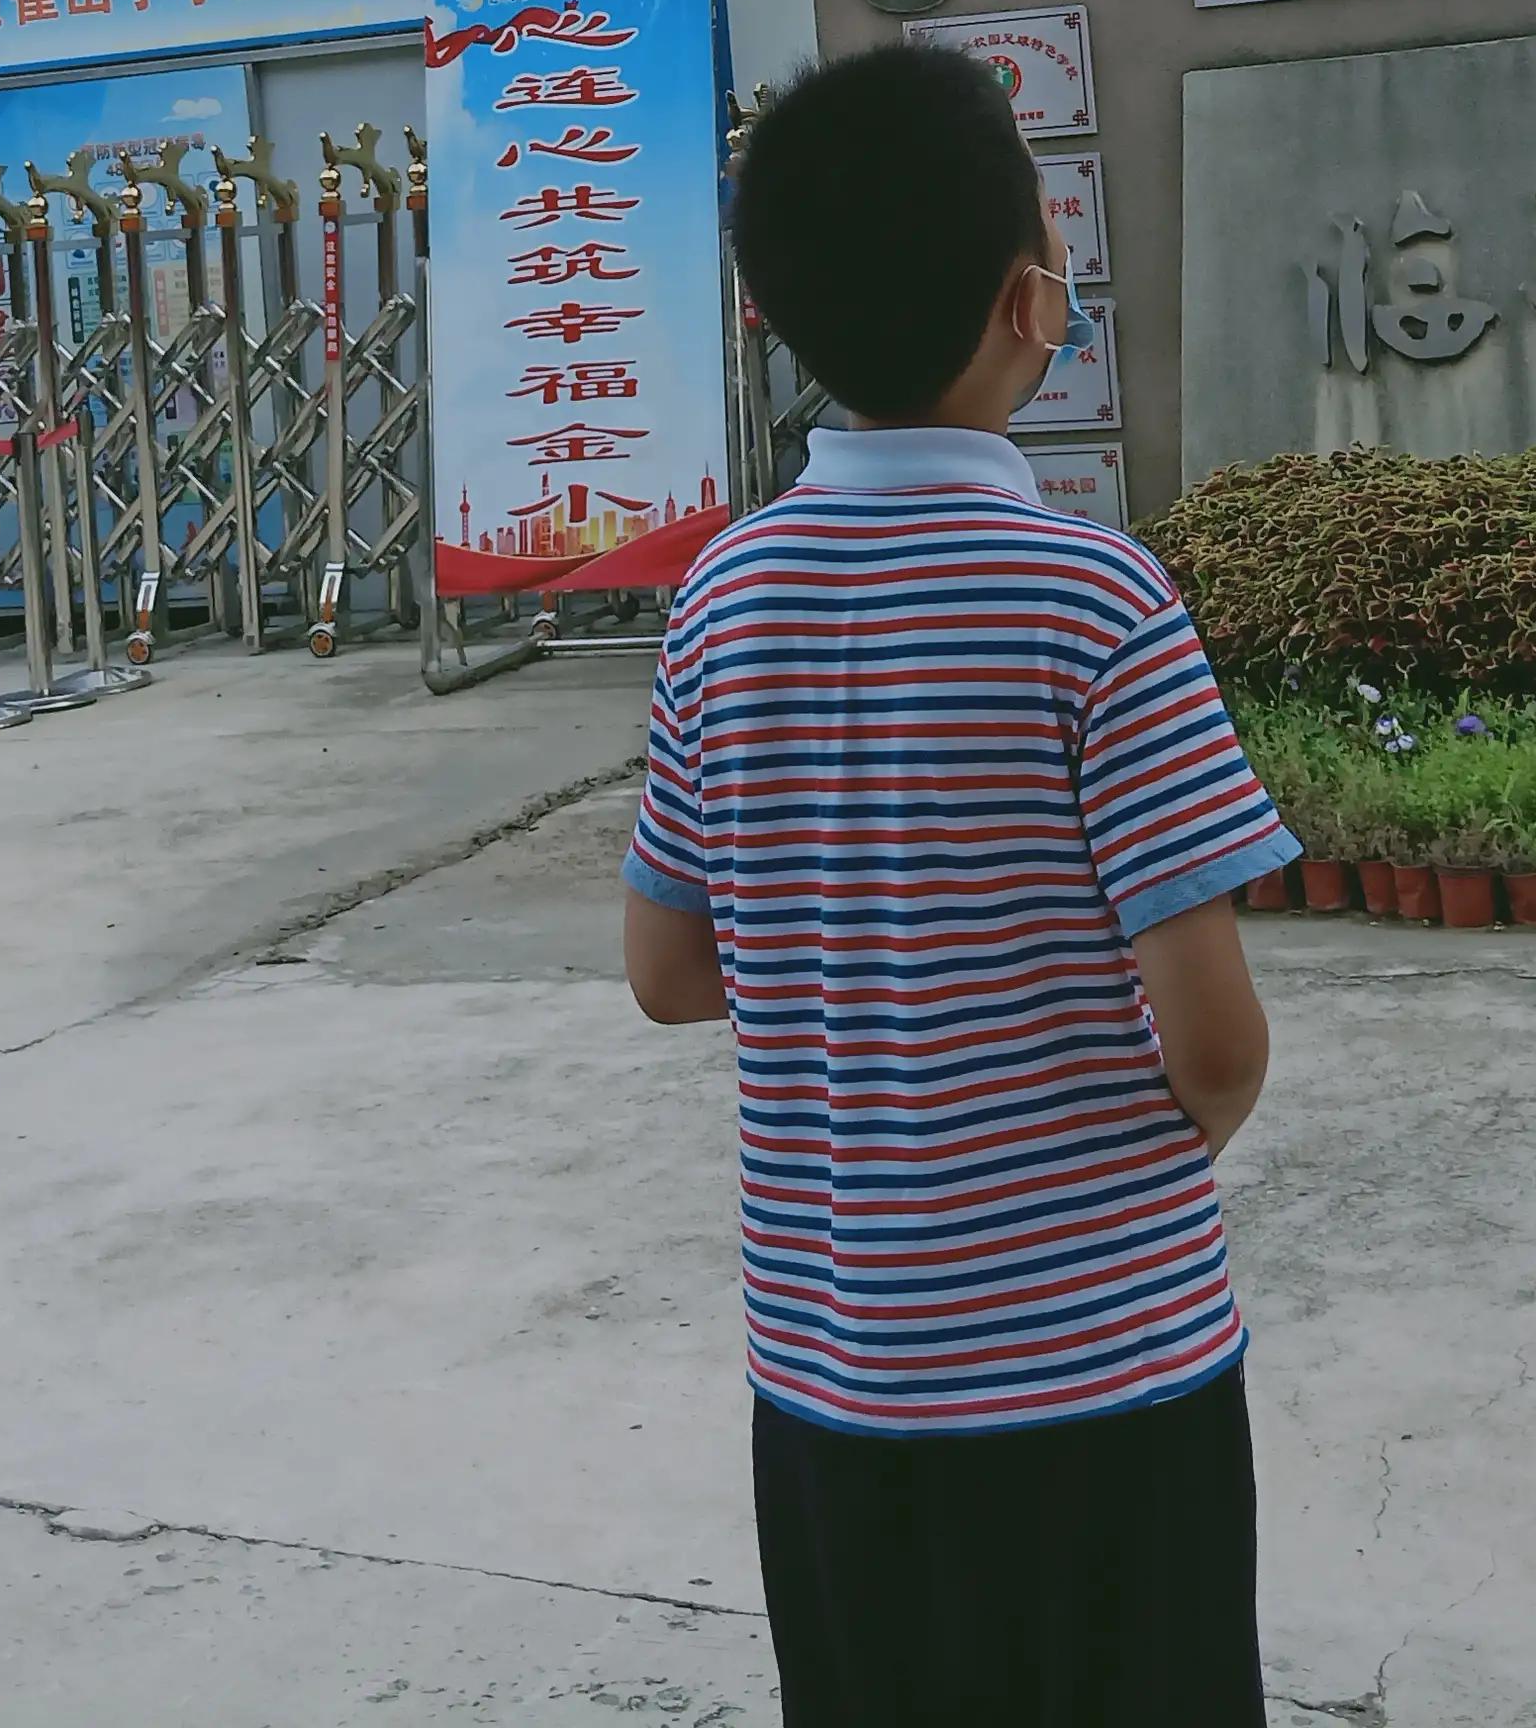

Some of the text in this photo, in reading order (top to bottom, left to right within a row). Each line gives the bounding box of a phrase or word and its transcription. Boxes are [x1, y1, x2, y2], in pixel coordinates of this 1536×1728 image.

[492, 8, 654, 523] 心连心共筑幸福金小
